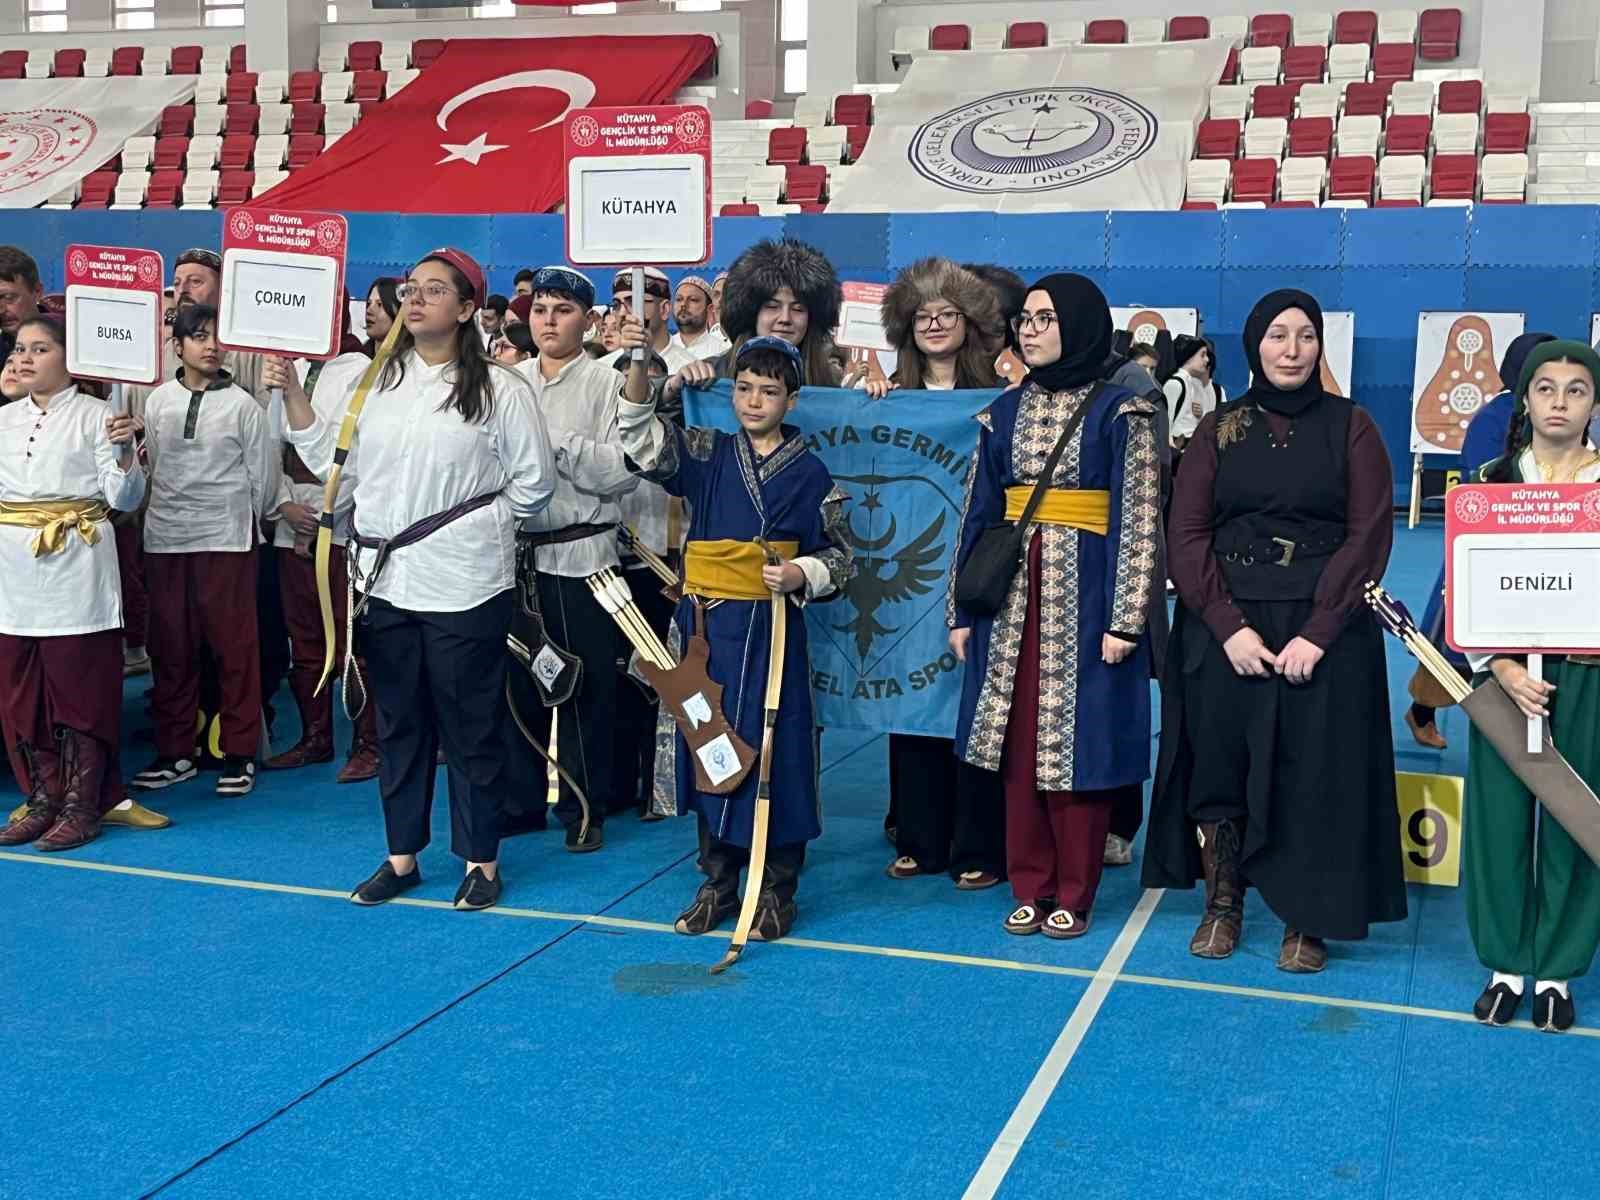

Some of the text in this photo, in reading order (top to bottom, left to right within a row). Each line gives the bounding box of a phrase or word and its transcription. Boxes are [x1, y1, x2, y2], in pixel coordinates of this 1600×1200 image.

[616, 113, 657, 124] KÜTAHYA
[600, 125, 674, 137] GENÇLİK VE SPOR
[615, 135, 669, 147] MÜDÜRLÜĞÜ
[601, 196, 677, 215] KÜTAHYA
[269, 213, 303, 226] KÜTAHYA
[254, 223, 316, 238] GENÇLİK VE SPOR
[266, 234, 311, 247] MÜDÜRLÜĞÜ
[255, 290, 306, 309] ÇORUM
[97, 326, 133, 342] BURSA
[1511, 489, 1560, 500] KÜTAHYA
[1491, 502, 1581, 514] GENÇLİK VE SPOR
[1497, 513, 1575, 525] İL MÜDÜRLÜĞÜ
[1499, 572, 1573, 591] DENİZLİ
[851, 677, 905, 700] ATA
[1407, 808, 1448, 868] 9
